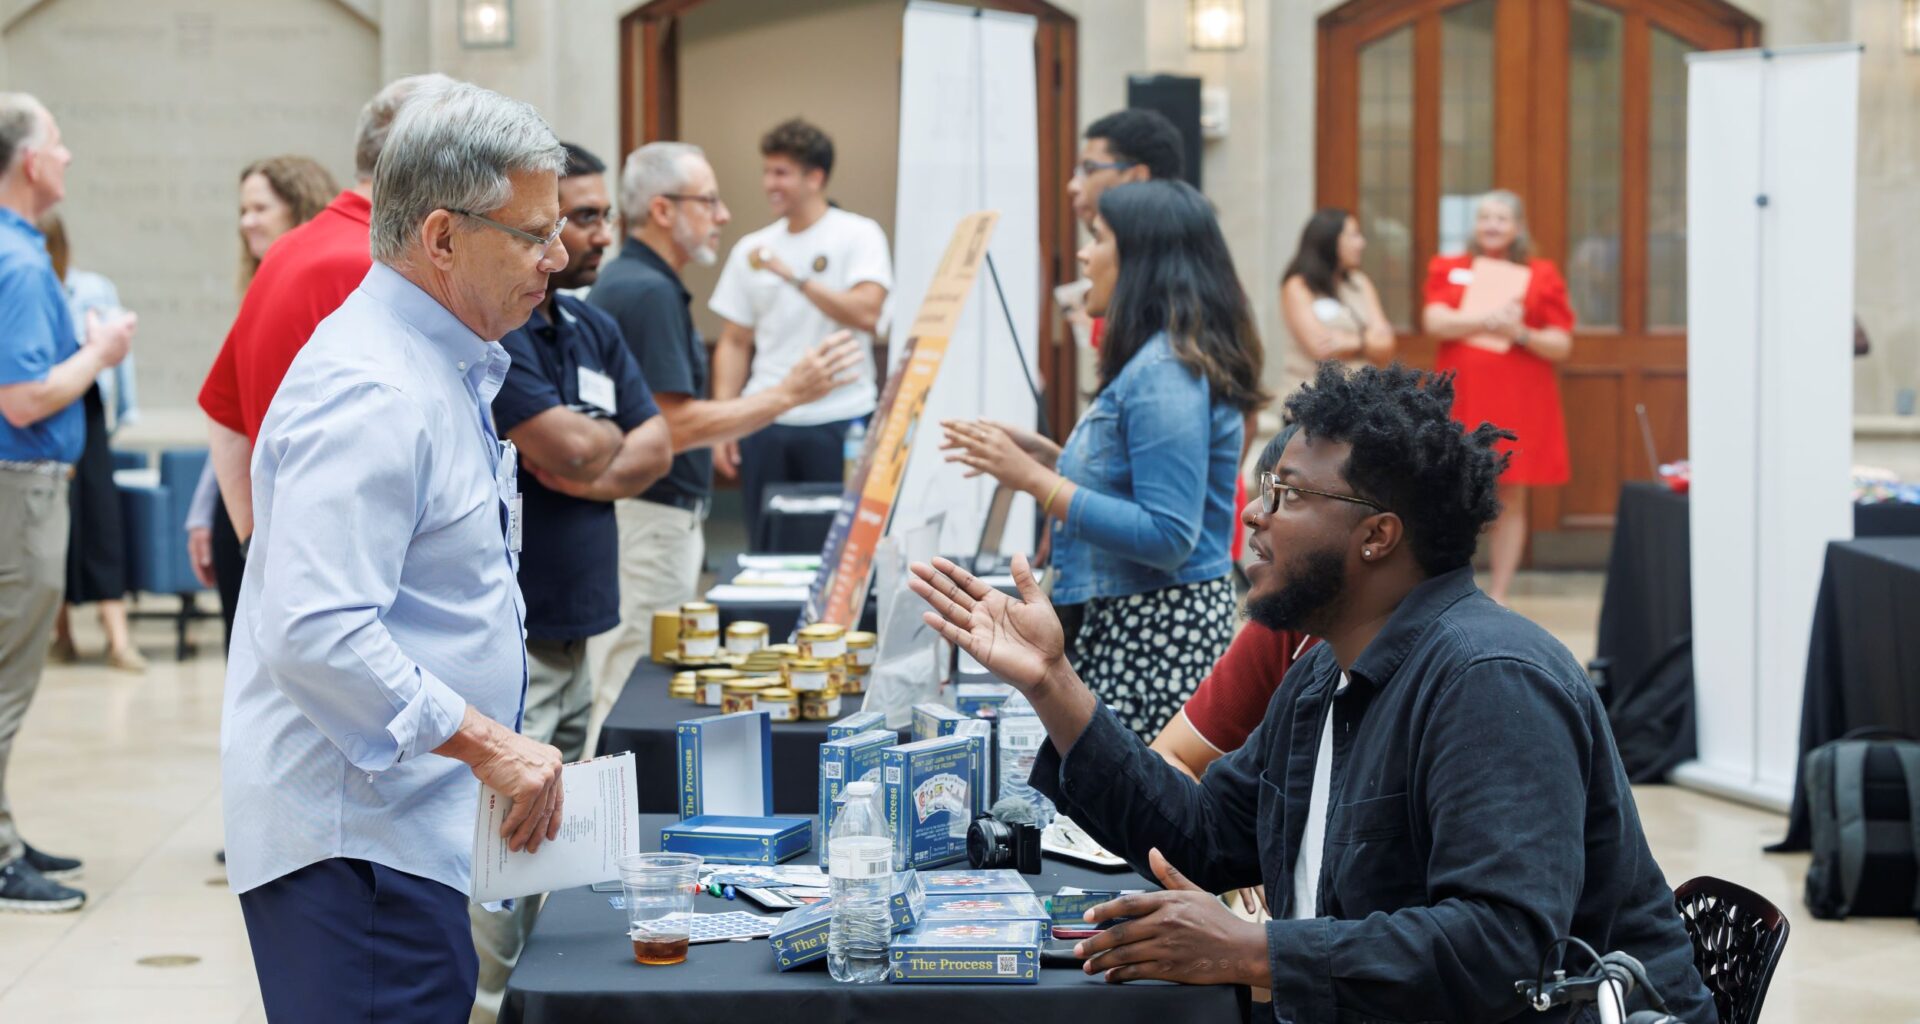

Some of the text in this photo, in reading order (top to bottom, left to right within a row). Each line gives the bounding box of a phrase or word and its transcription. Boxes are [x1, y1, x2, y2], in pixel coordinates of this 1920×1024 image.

[685, 749, 694, 816] The Process
[791, 938, 817, 953] The
[910, 958, 993, 971] The Process
